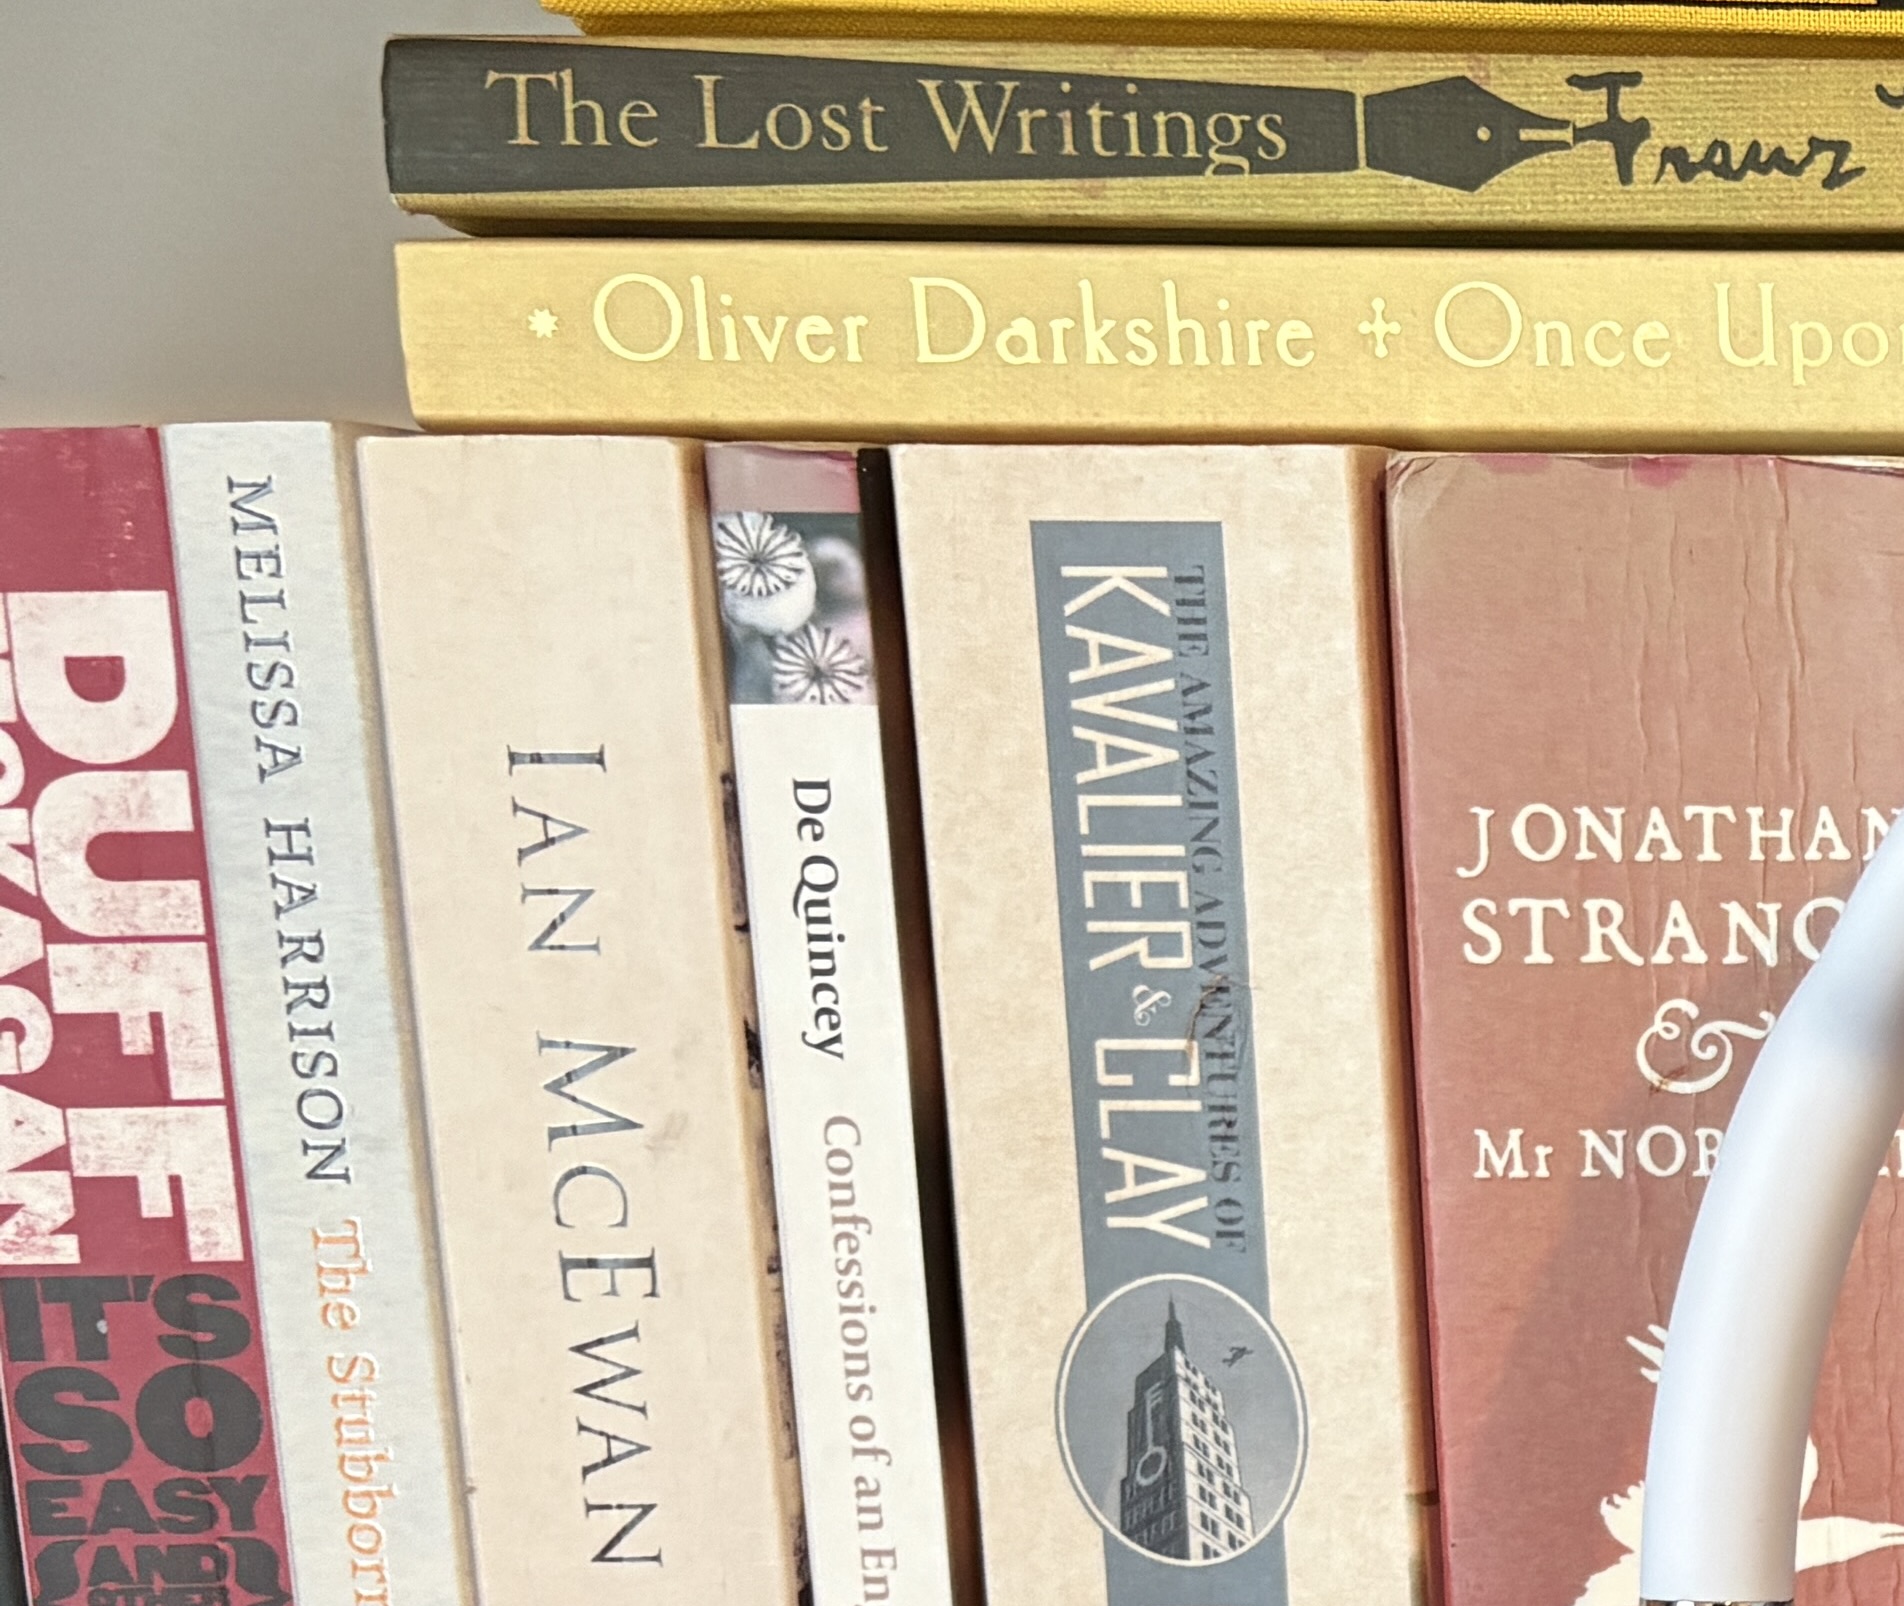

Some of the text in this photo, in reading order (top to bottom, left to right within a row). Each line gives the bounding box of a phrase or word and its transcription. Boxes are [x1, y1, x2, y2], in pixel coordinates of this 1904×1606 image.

[486, 68, 1287, 176] The Lost Writings
[593, 272, 869, 364] Oliver
[910, 276, 1314, 369] Darkshire
[1434, 279, 1672, 370] Once
[226, 474, 352, 1186] MELISSA HARRISON
[506, 744, 608, 955] IAN
[6, 590, 244, 1262] DUFF
[791, 776, 846, 1061] De Quincey
[1059, 564, 1212, 1251] KAVALIER & CLAY
[1173, 563, 1250, 1254] THE AMAZING ADVENTURES OF
[1636, 998, 1777, 1094] &
[1472, 1128, 1554, 1180] Mr
[310, 1217, 373, 1330] The
[822, 1113, 875, 1407] Confessions
[0, 1274, 251, 1362] IT'S
[14, 1363, 263, 1475] SO
[851, 1414, 893, 1471] of
[24, 1475, 267, 1535] EASY
[854, 1474, 889, 1537] an
[89, 1544, 227, 1584] AND
